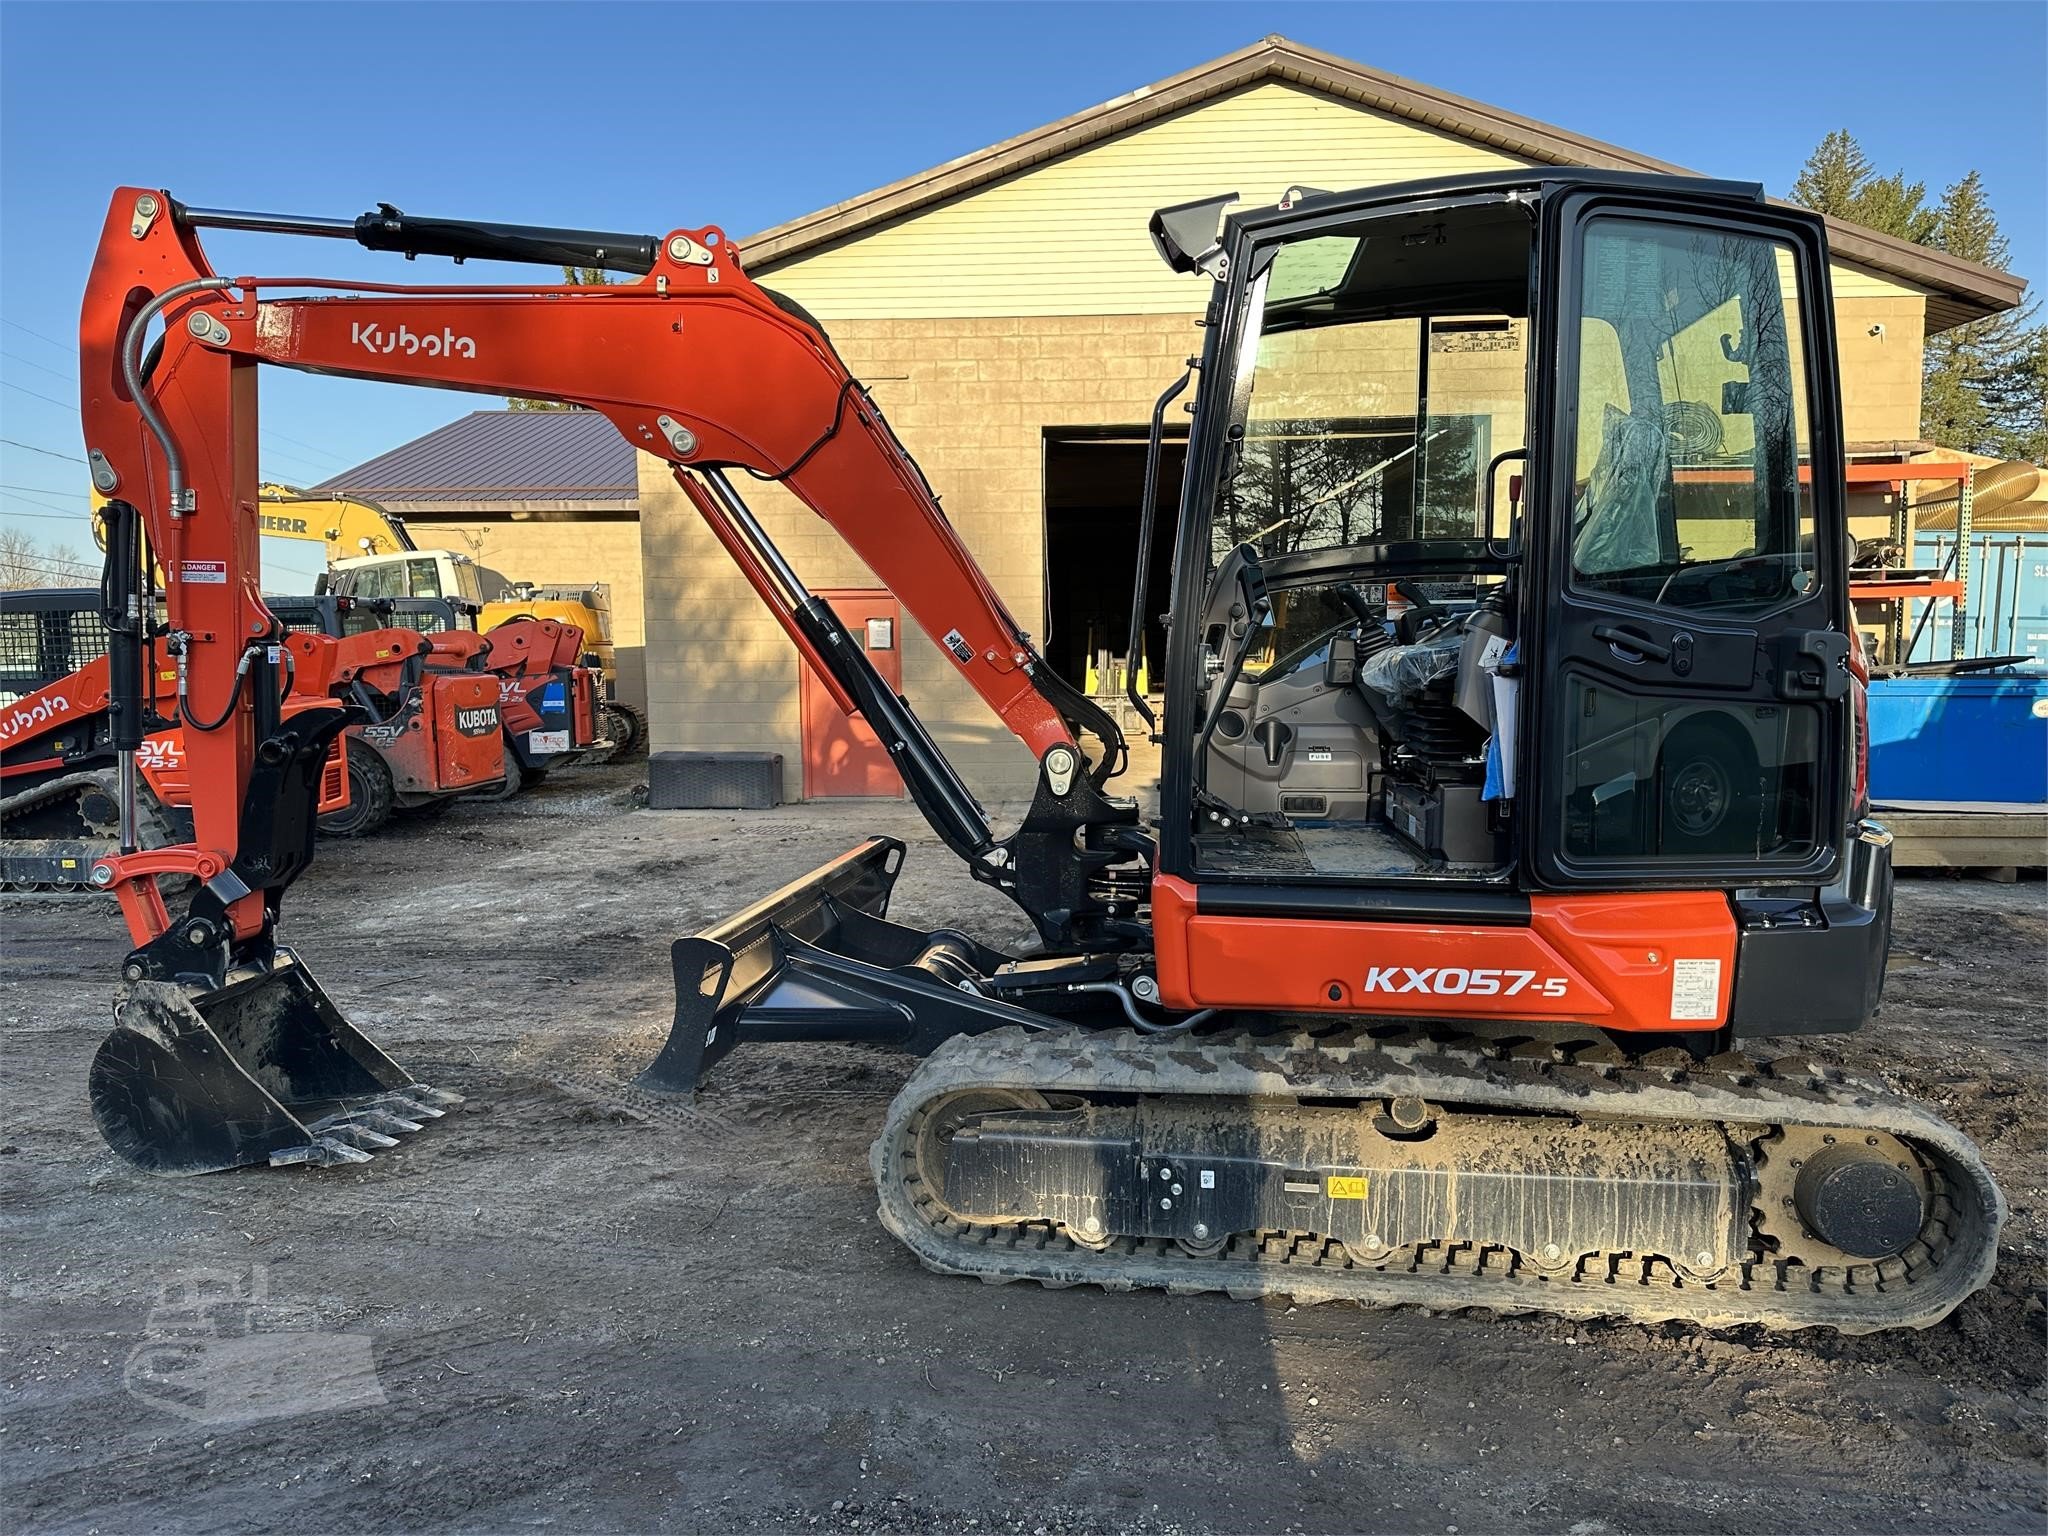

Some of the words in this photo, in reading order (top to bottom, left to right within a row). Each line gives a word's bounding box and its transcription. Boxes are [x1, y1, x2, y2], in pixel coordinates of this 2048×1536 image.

[352, 322, 476, 358] Kubota
[187, 563, 216, 571] DANGER
[459, 708, 498, 729] KUBOTA
[364, 726, 405, 737] SSV
[135, 740, 184, 756] SVL
[140, 756, 179, 768] 75-2
[1364, 967, 1569, 997] KX057-5
